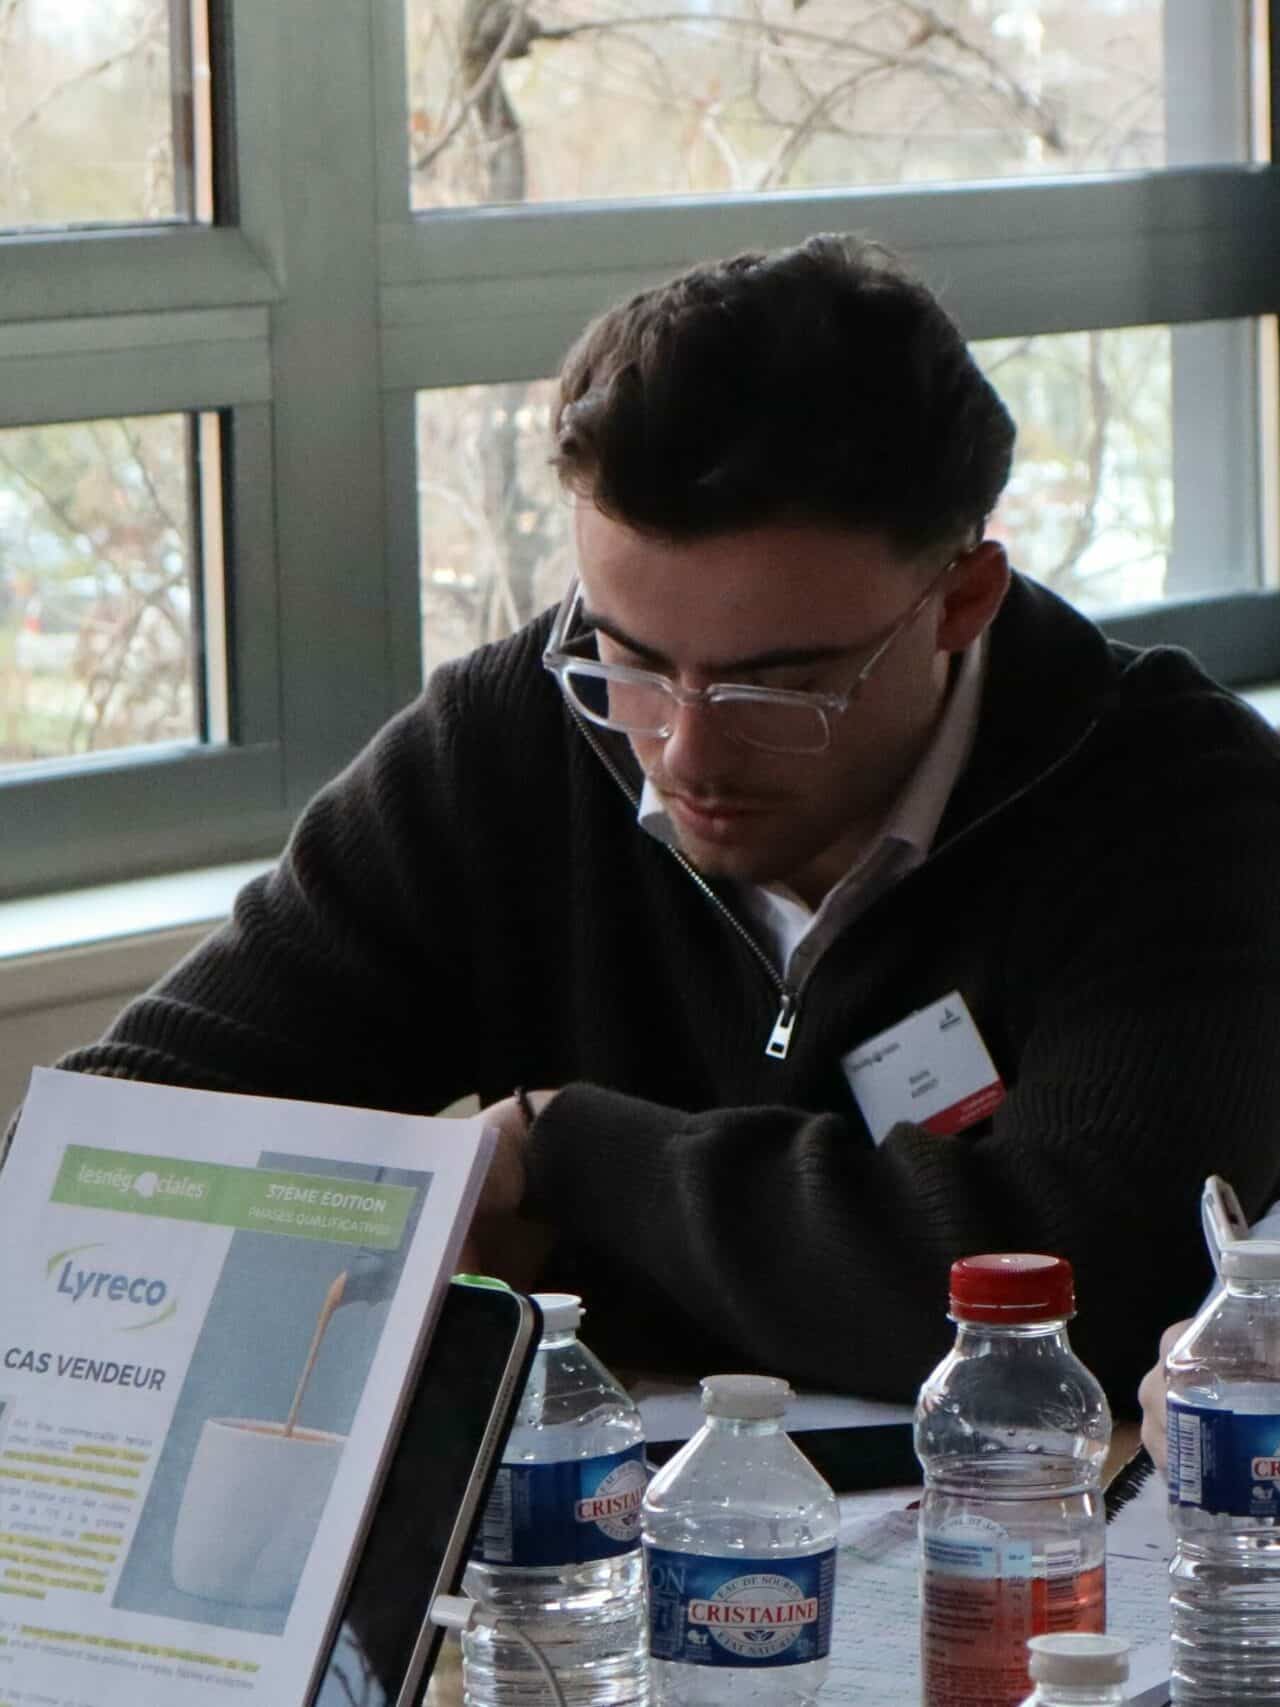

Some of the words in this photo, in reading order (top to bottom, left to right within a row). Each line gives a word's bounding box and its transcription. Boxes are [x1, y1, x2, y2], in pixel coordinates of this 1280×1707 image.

[56, 1259, 168, 1307] Lyreco
[4, 1347, 52, 1374] CAS
[56, 1354, 166, 1392] VENDEUR
[691, 1602, 816, 1624] CRISTALINE
